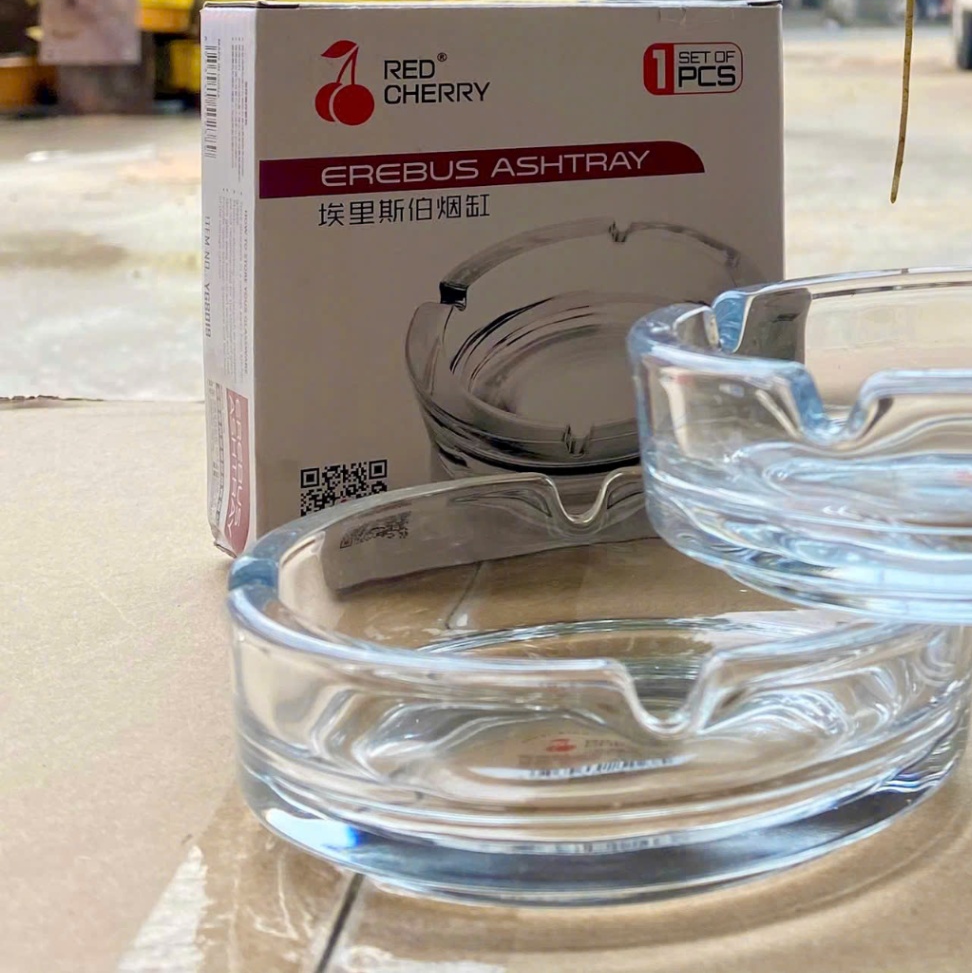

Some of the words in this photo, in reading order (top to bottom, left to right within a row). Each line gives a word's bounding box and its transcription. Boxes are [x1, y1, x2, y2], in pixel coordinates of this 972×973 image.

[652, 48, 666, 90] 1
[678, 51, 711, 64] SET
[714, 50, 736, 63] OF
[678, 65, 736, 88] PCS
[384, 82, 491, 105] CHERRY
[321, 159, 479, 187] EREBUS
[491, 150, 650, 178] ASHTRAY
[318, 194, 490, 227] 埃里斯伯烟缸
